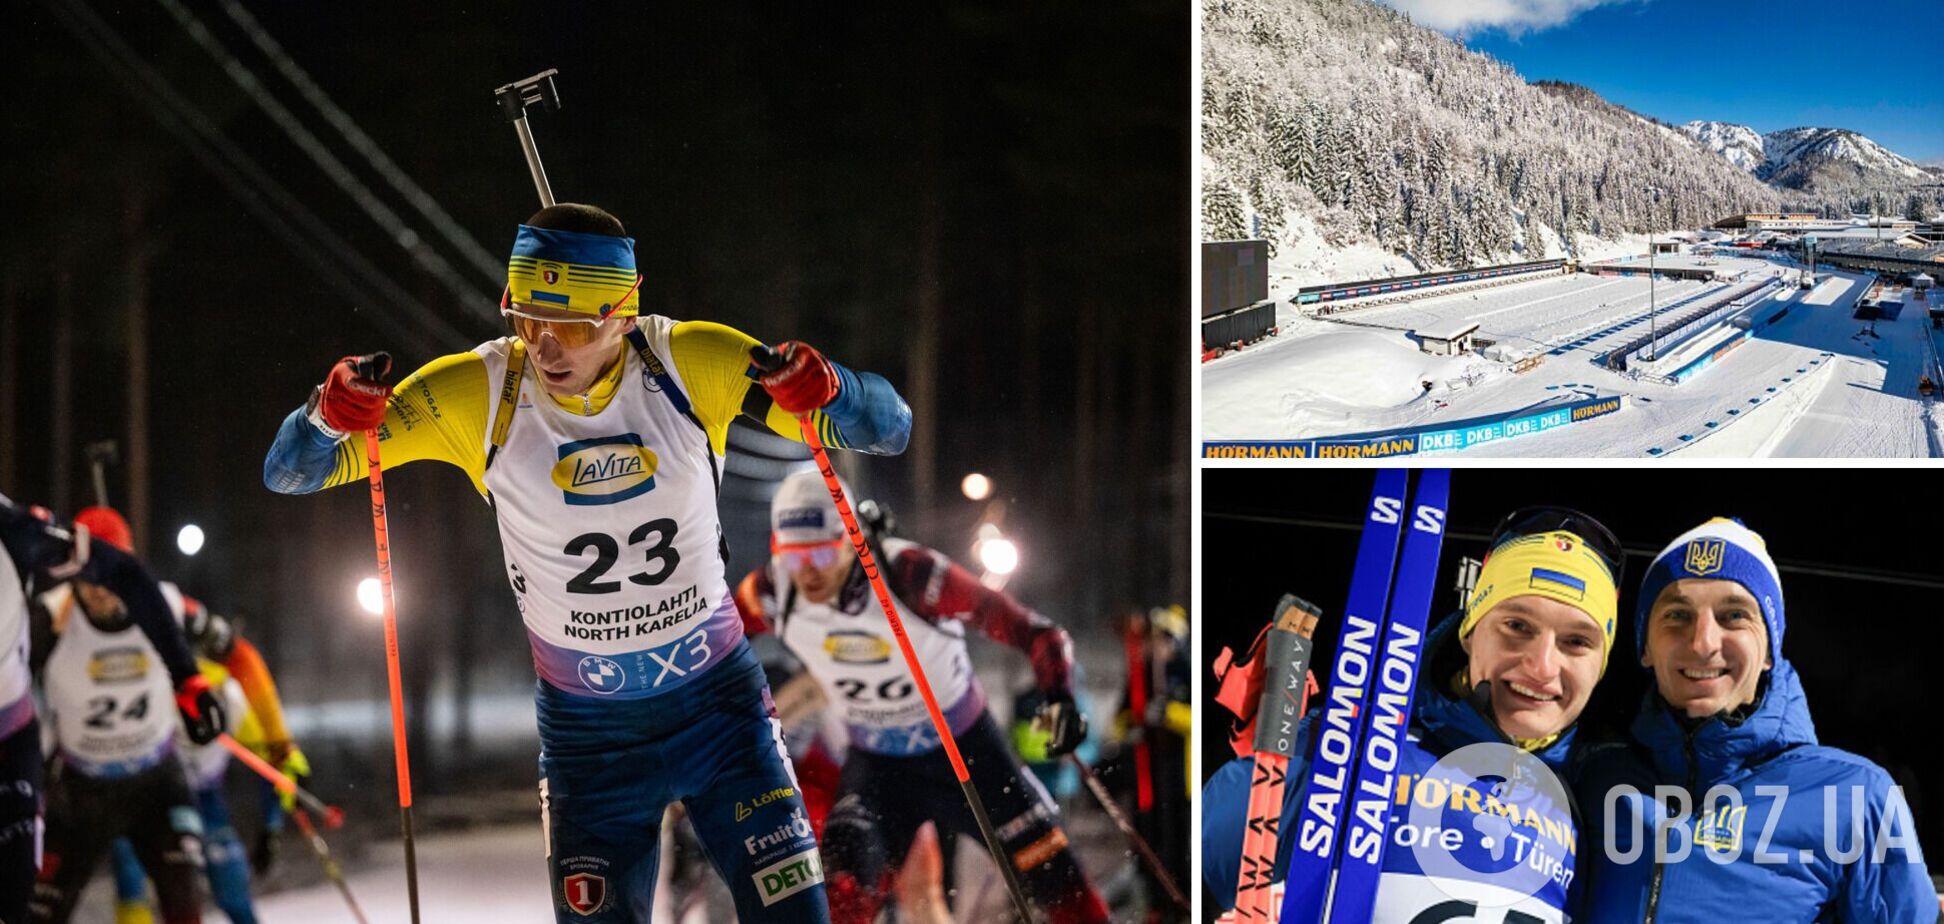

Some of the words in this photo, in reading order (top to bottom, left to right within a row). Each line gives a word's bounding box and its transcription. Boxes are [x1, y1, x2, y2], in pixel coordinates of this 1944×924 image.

[502, 369, 519, 404] biatar
[1466, 428, 1493, 444] DKB
[1506, 421, 1530, 436] DKB
[1540, 414, 1560, 428] DKB
[1205, 444, 1306, 458] HÖRMANN
[1318, 438, 1414, 458] HÖRMANN
[1422, 434, 1454, 450] DKB
[563, 518, 680, 594] 23
[564, 623, 630, 641] NORTH
[635, 597, 708, 636] KARELIA
[571, 585, 698, 625] KONTIOLAHTI
[648, 629, 711, 688] X3
[86, 692, 150, 730] 24
[1277, 639, 1305, 752] ONE/WAY
[1300, 616, 1378, 858] SALOMON
[1348, 622, 1421, 865] SALOMON
[1389, 815, 1464, 851] ore
[1511, 832, 1575, 890] Türen
[575, 880, 594, 905] 1
